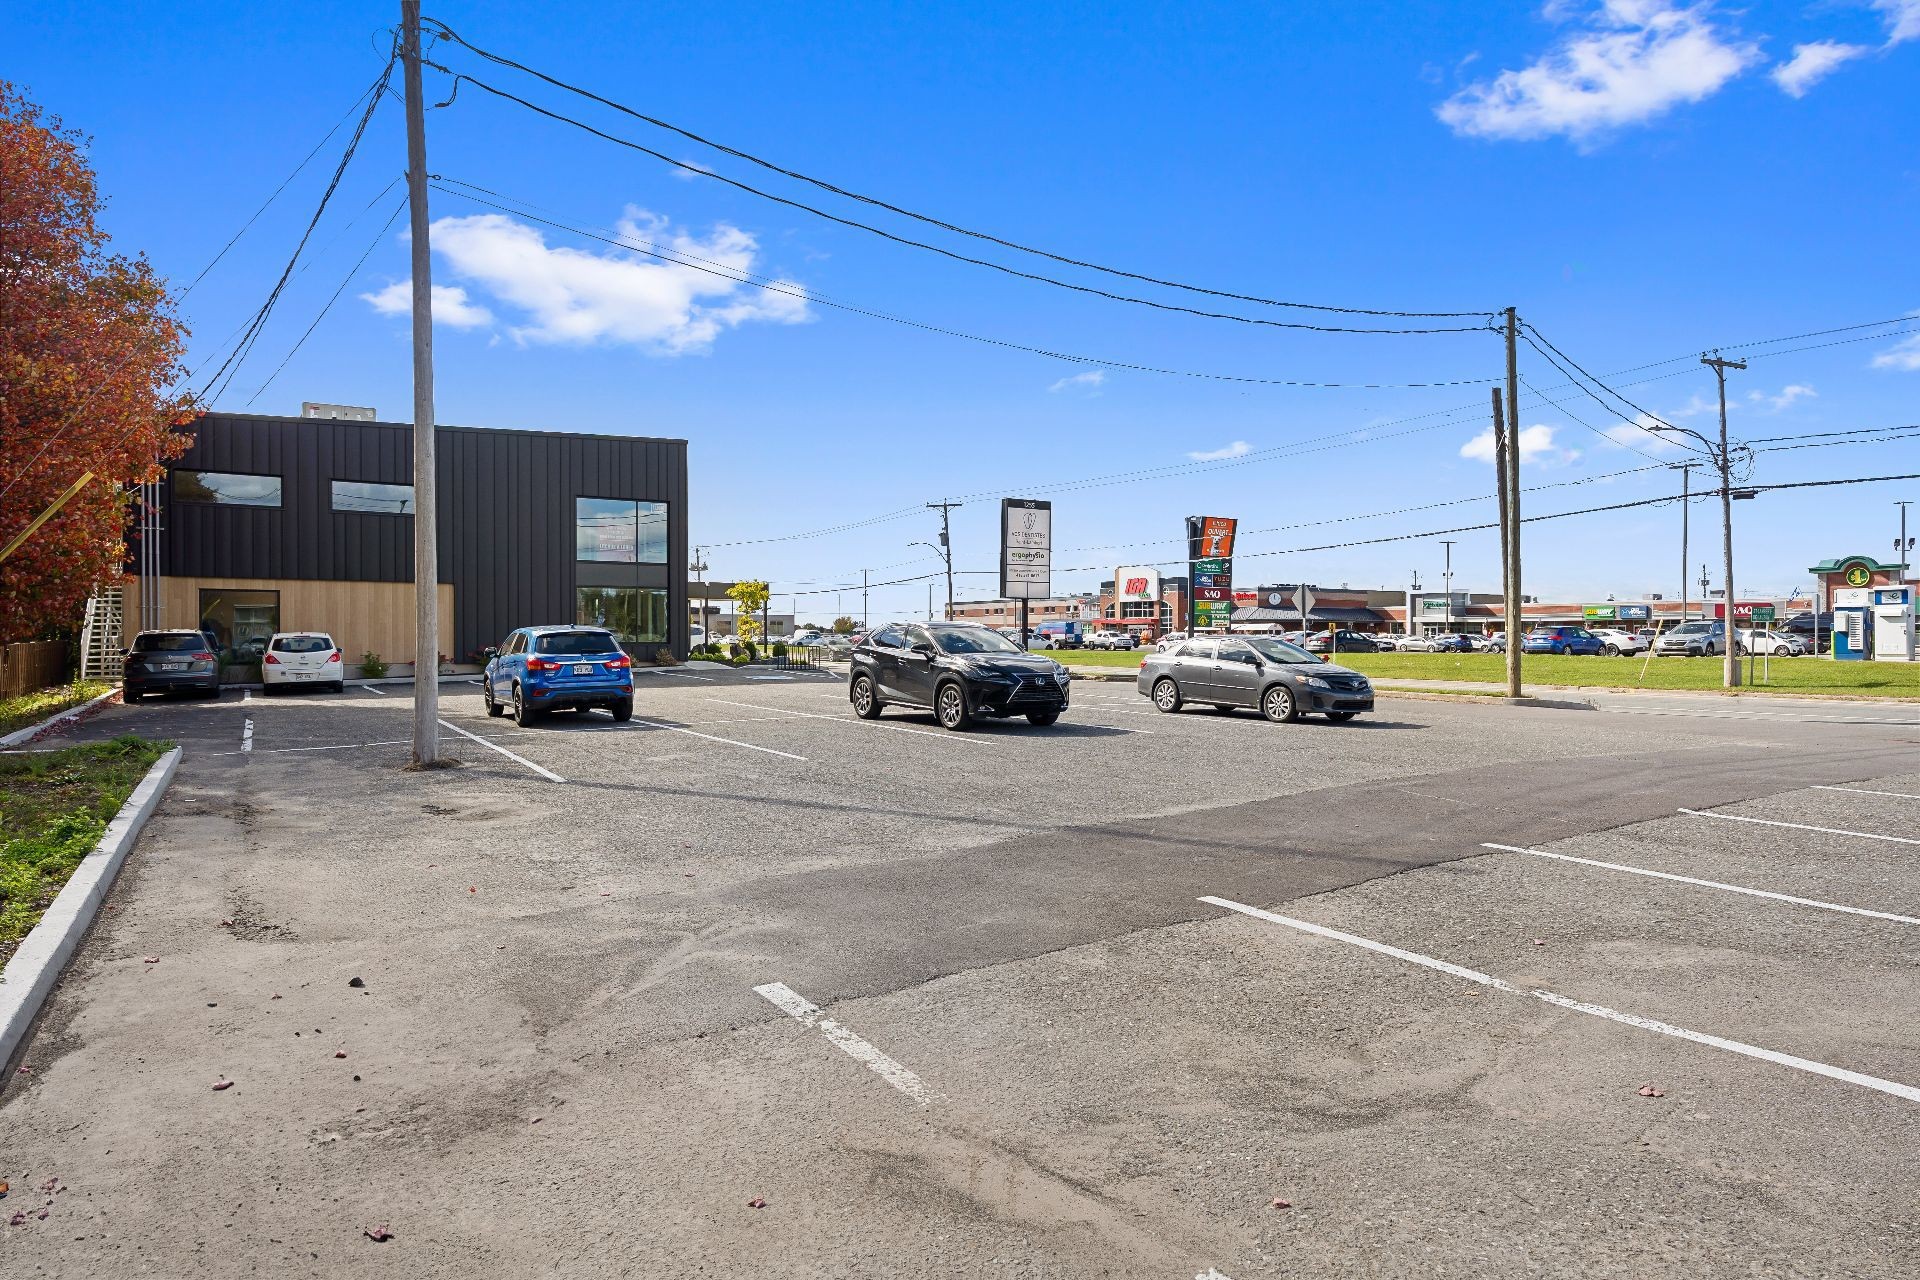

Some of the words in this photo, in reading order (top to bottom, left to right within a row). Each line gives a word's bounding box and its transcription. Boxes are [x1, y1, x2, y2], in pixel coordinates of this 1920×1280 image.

[1011, 551, 1045, 561] ergophysio
[1125, 577, 1148, 595] IGA
[1198, 602, 1227, 610] SUBWAY
[1586, 607, 1614, 616] SUBWAY
